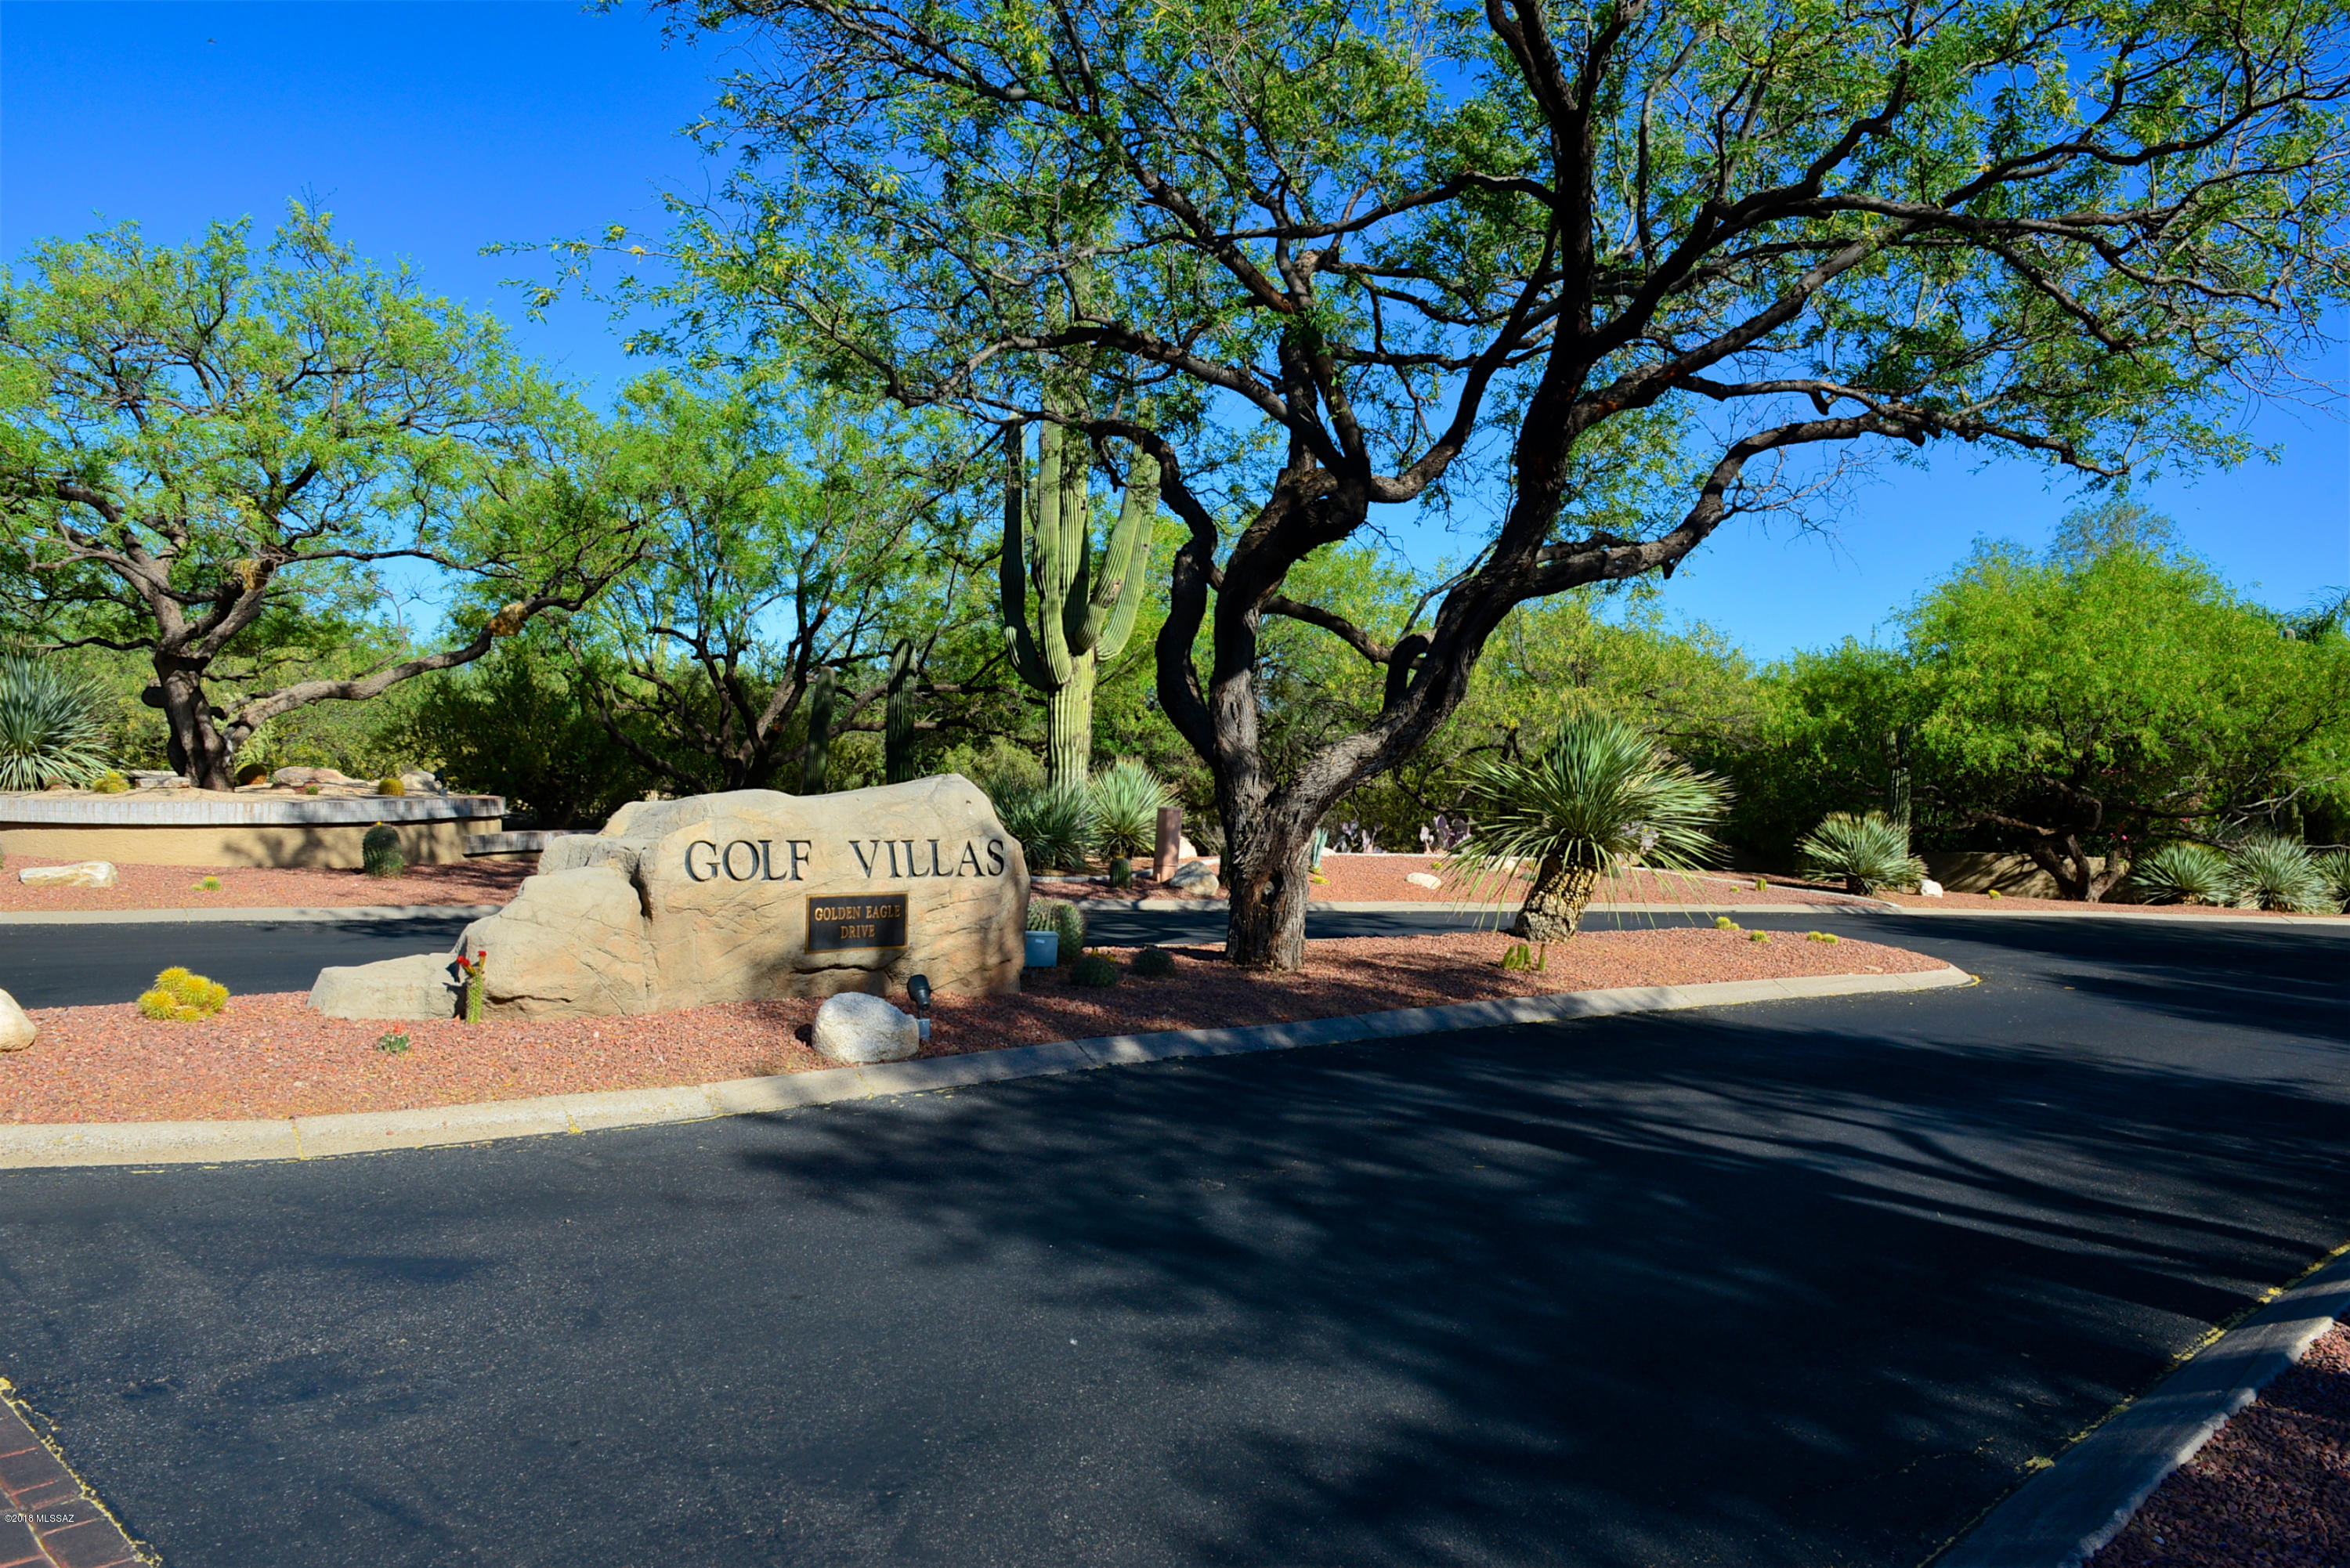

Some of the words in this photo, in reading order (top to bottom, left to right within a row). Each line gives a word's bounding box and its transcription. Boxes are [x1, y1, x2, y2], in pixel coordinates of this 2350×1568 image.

[685, 840, 812, 881] GOLF
[848, 839, 1005, 878] VILLAS
[815, 905, 861, 921] GOLDEN
[866, 905, 901, 919] EAGLE
[841, 924, 876, 939] DRIVE
